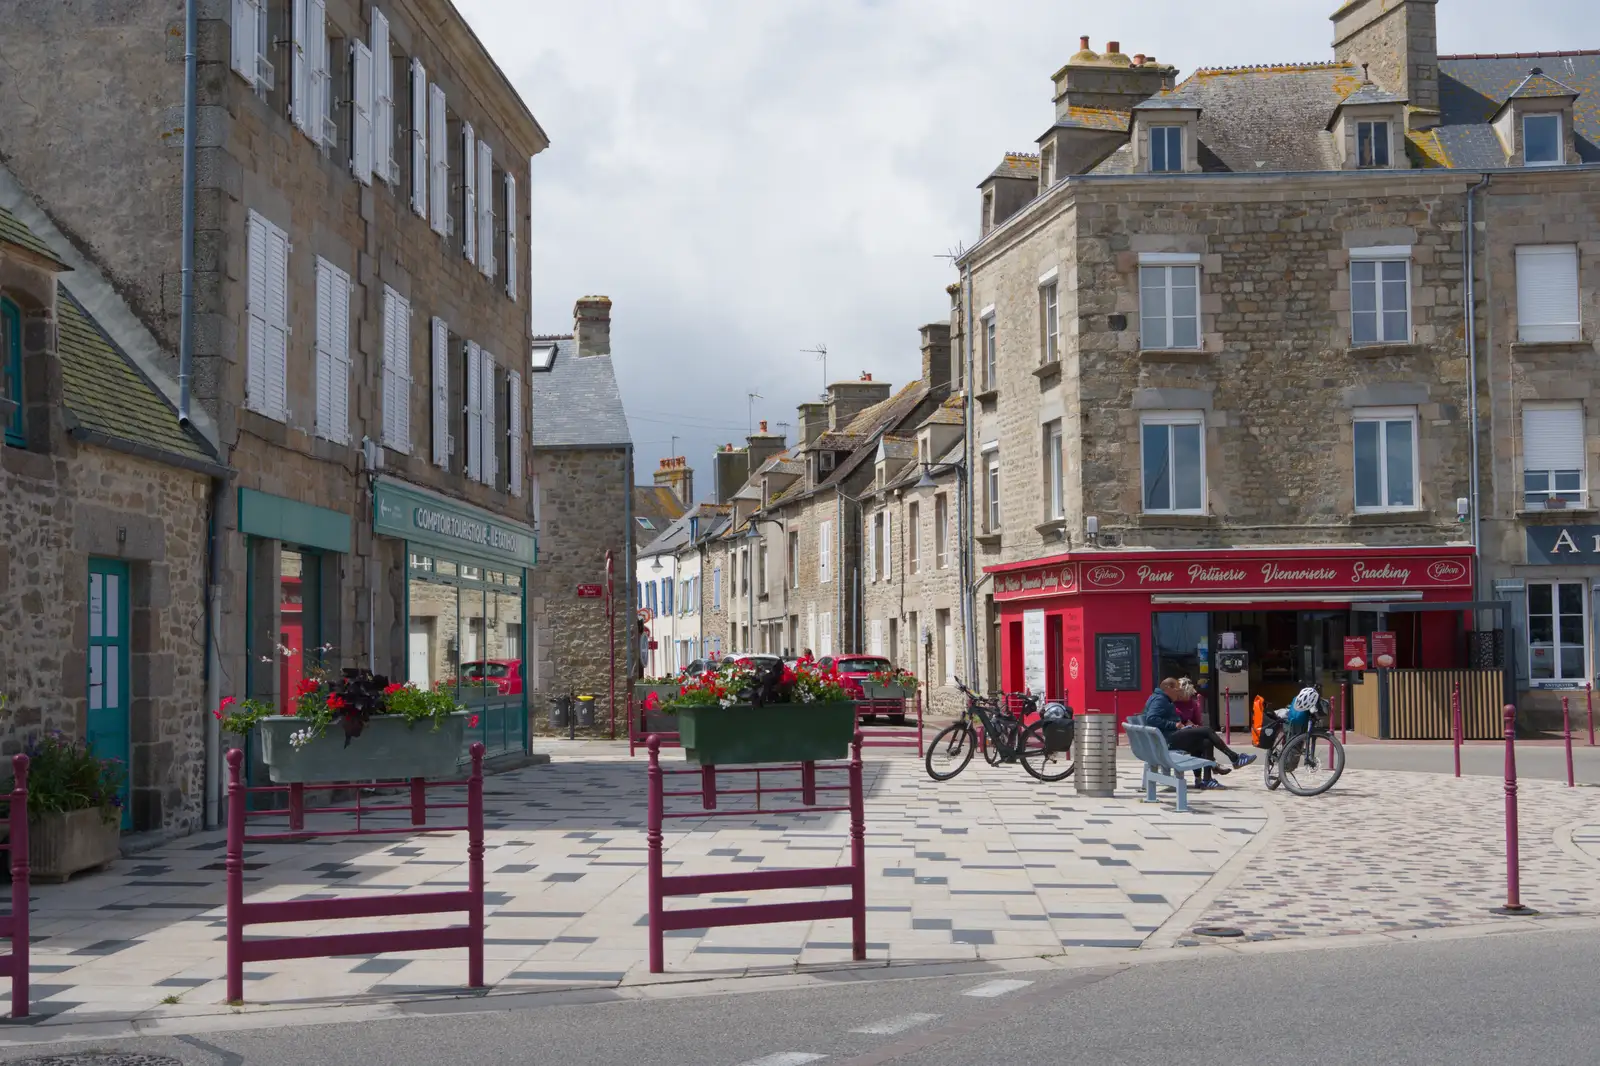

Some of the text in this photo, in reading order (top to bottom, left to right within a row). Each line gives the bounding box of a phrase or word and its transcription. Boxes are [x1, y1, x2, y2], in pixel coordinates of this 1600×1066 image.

[417, 507, 450, 536] COMPTOIR
[451, 517, 487, 545] TOURISTIQUE
[1094, 567, 1118, 582] Gibon
[1137, 561, 1411, 584] Pains Pâtisserie Viennoiserie Snacking
[1434, 563, 1459, 578] Gibon
